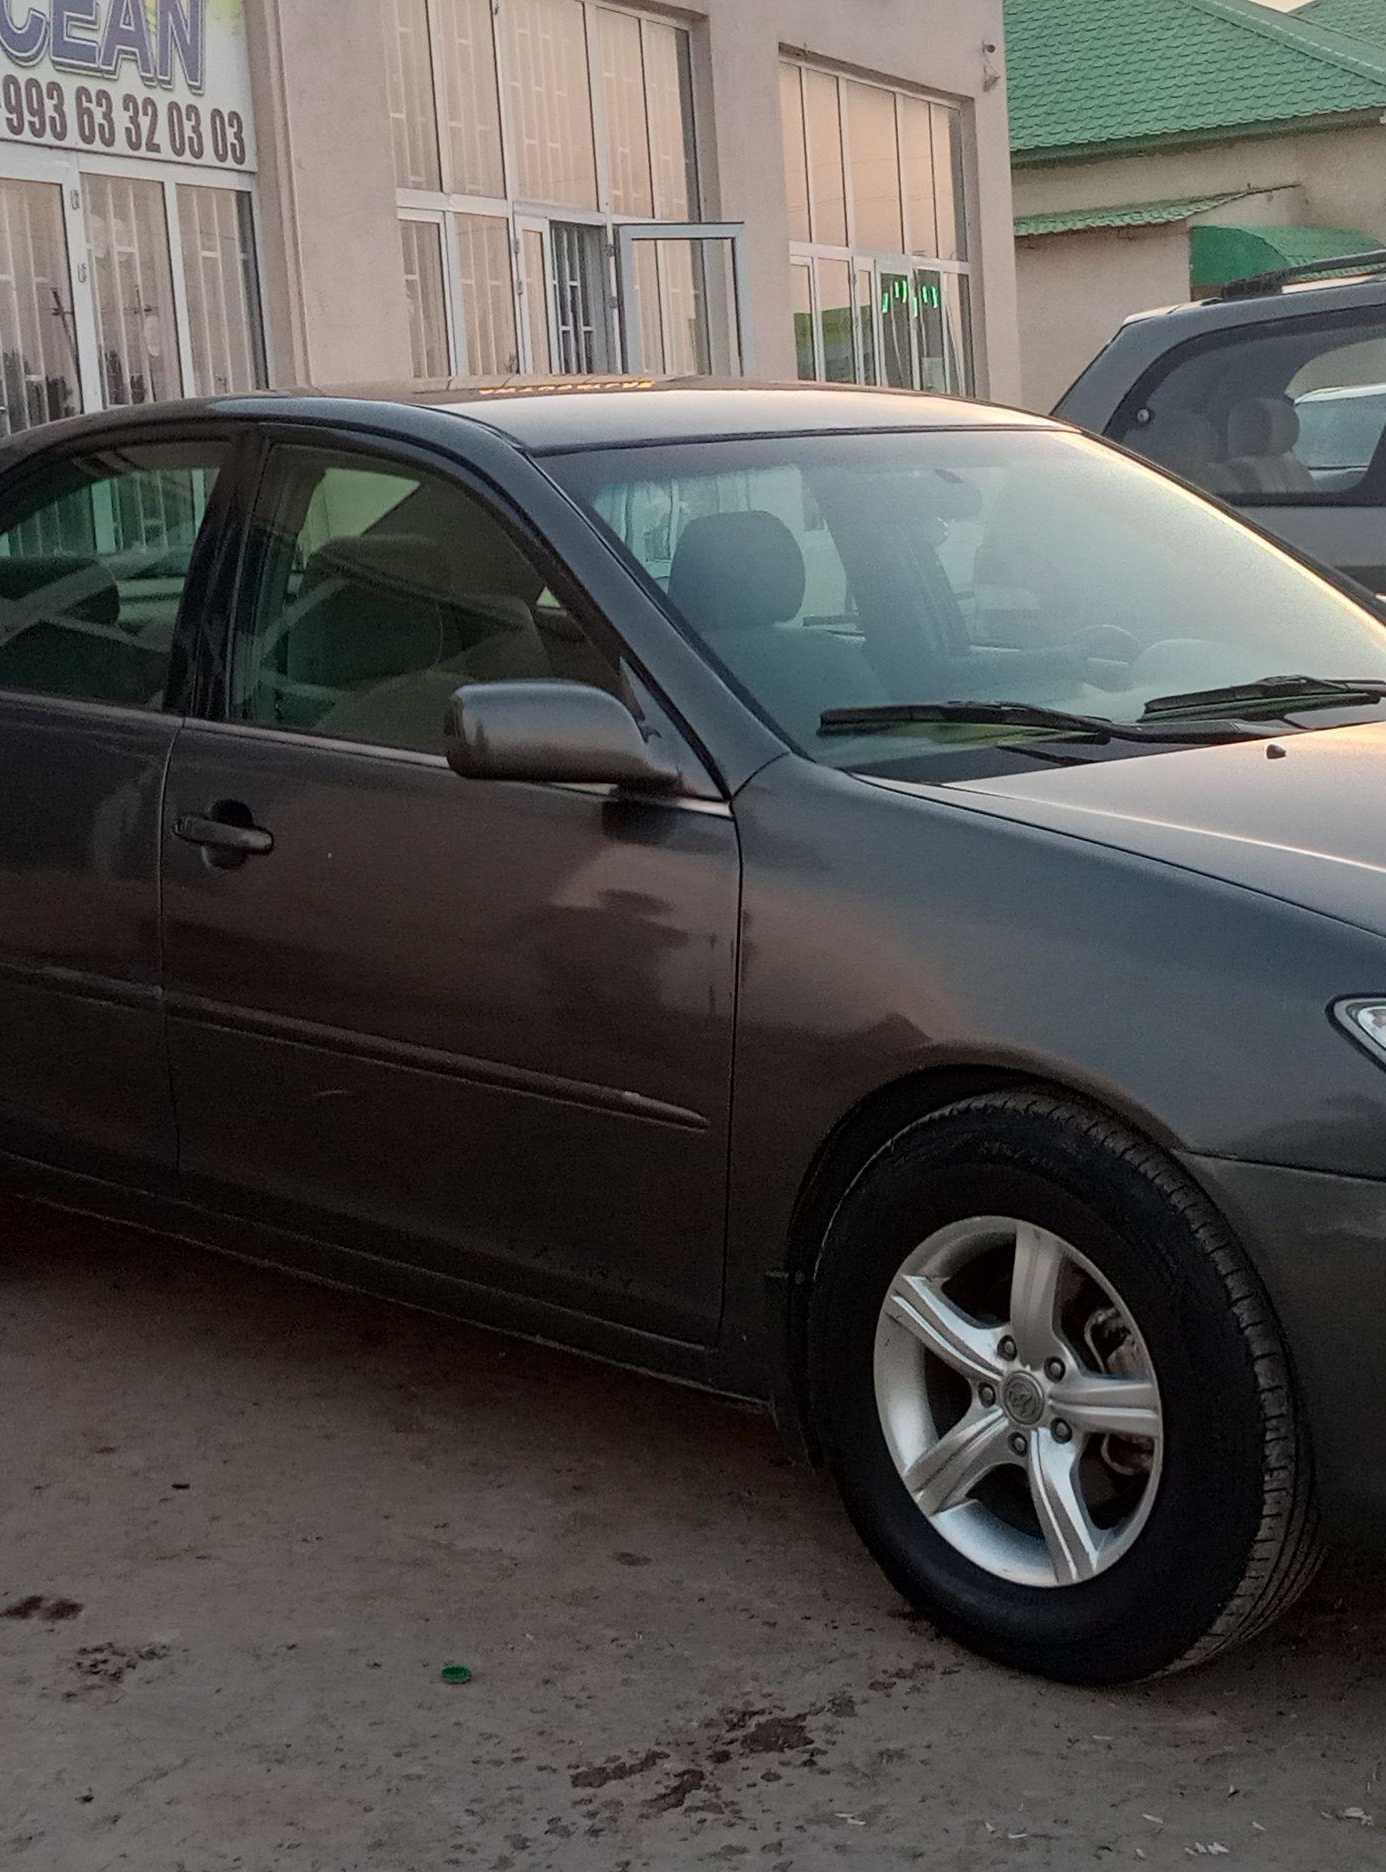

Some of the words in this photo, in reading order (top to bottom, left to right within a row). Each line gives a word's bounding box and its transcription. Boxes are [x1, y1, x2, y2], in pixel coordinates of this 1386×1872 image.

[75, 86, 116, 147] 63
[123, 93, 162, 153] 32
[167, 101, 205, 160] 03
[211, 108, 247, 166] 03
